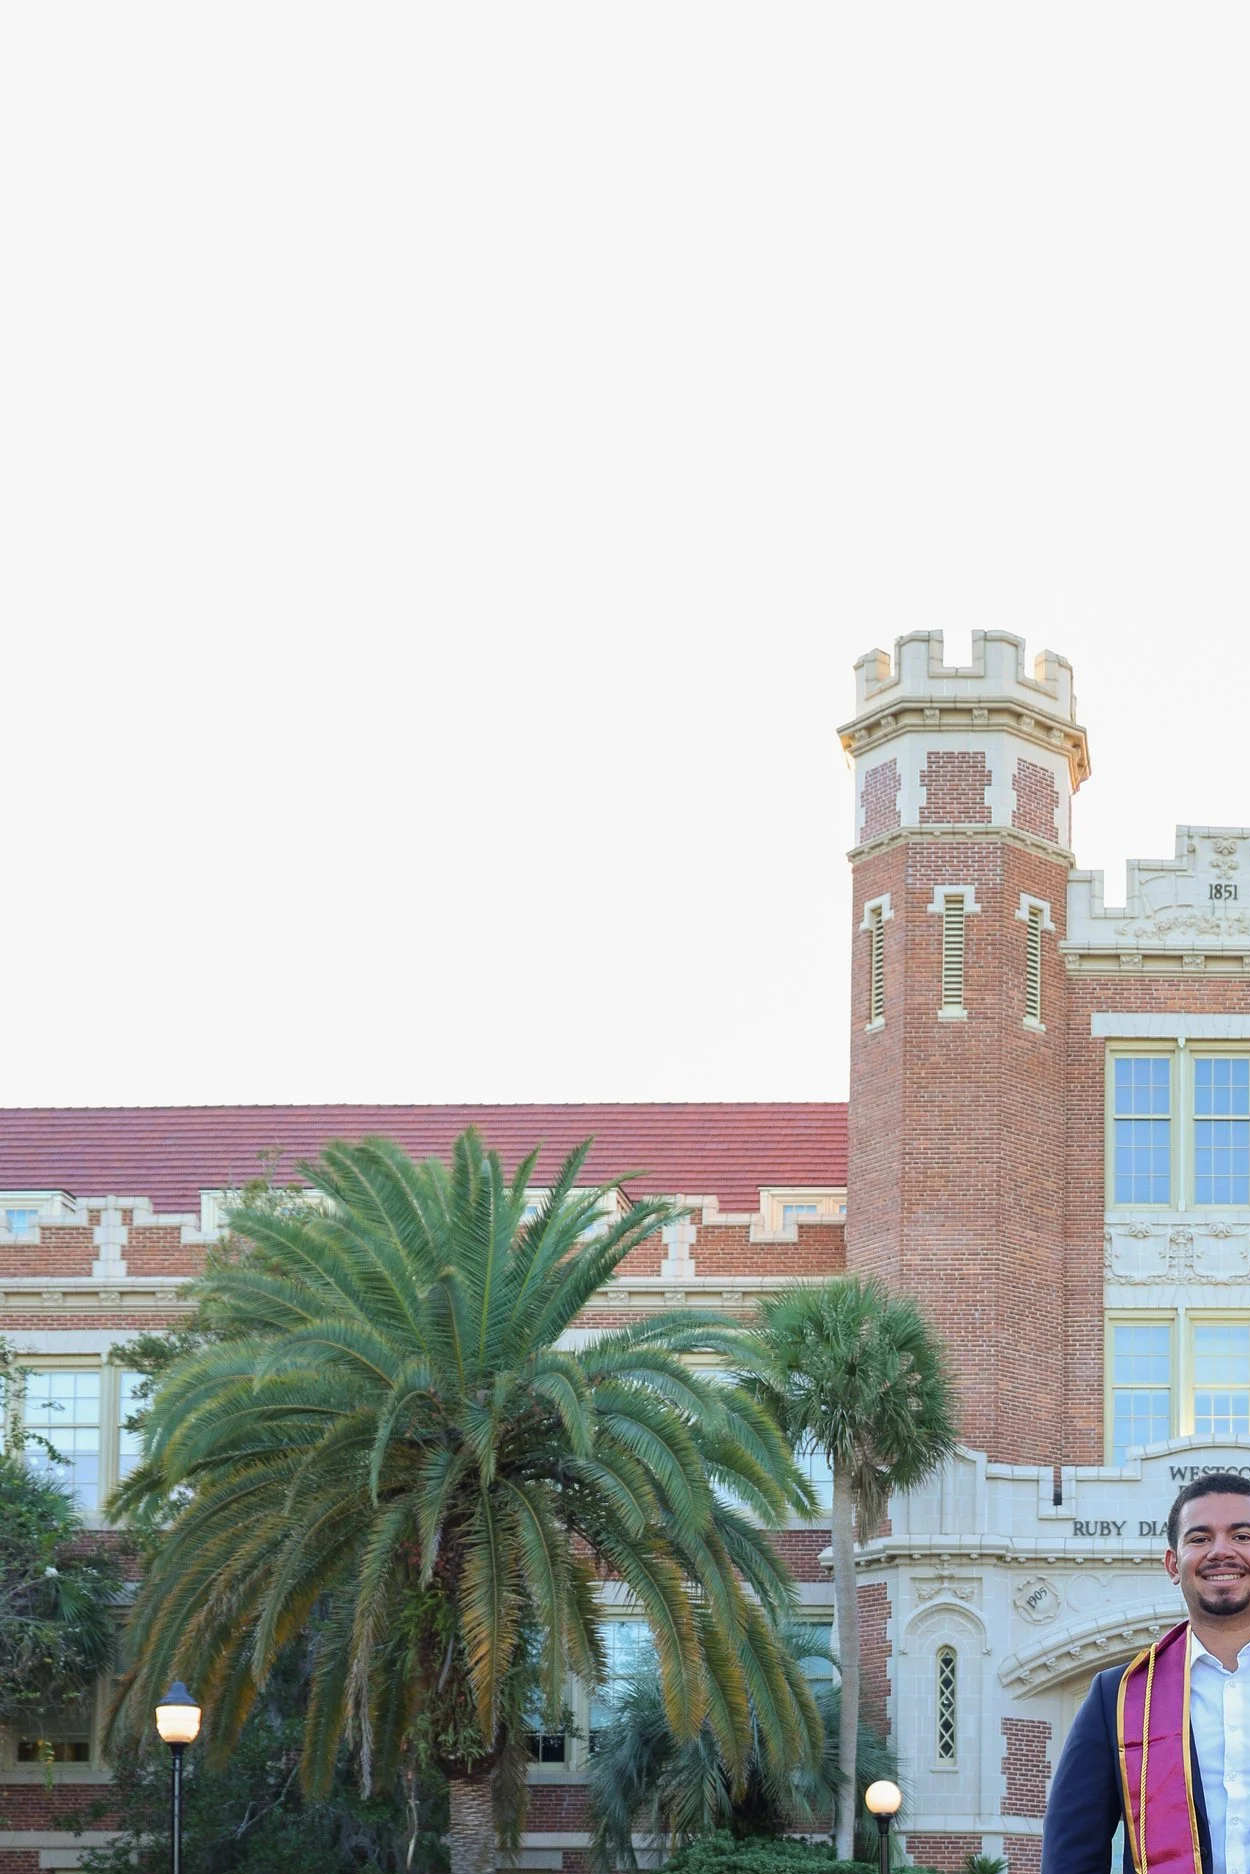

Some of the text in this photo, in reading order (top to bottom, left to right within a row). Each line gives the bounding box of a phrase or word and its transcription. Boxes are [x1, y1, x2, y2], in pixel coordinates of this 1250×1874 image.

[1208, 883, 1238, 901] 1851
[1072, 1520, 1127, 1537] RUBY
[1026, 1586, 1047, 1609] 1905
